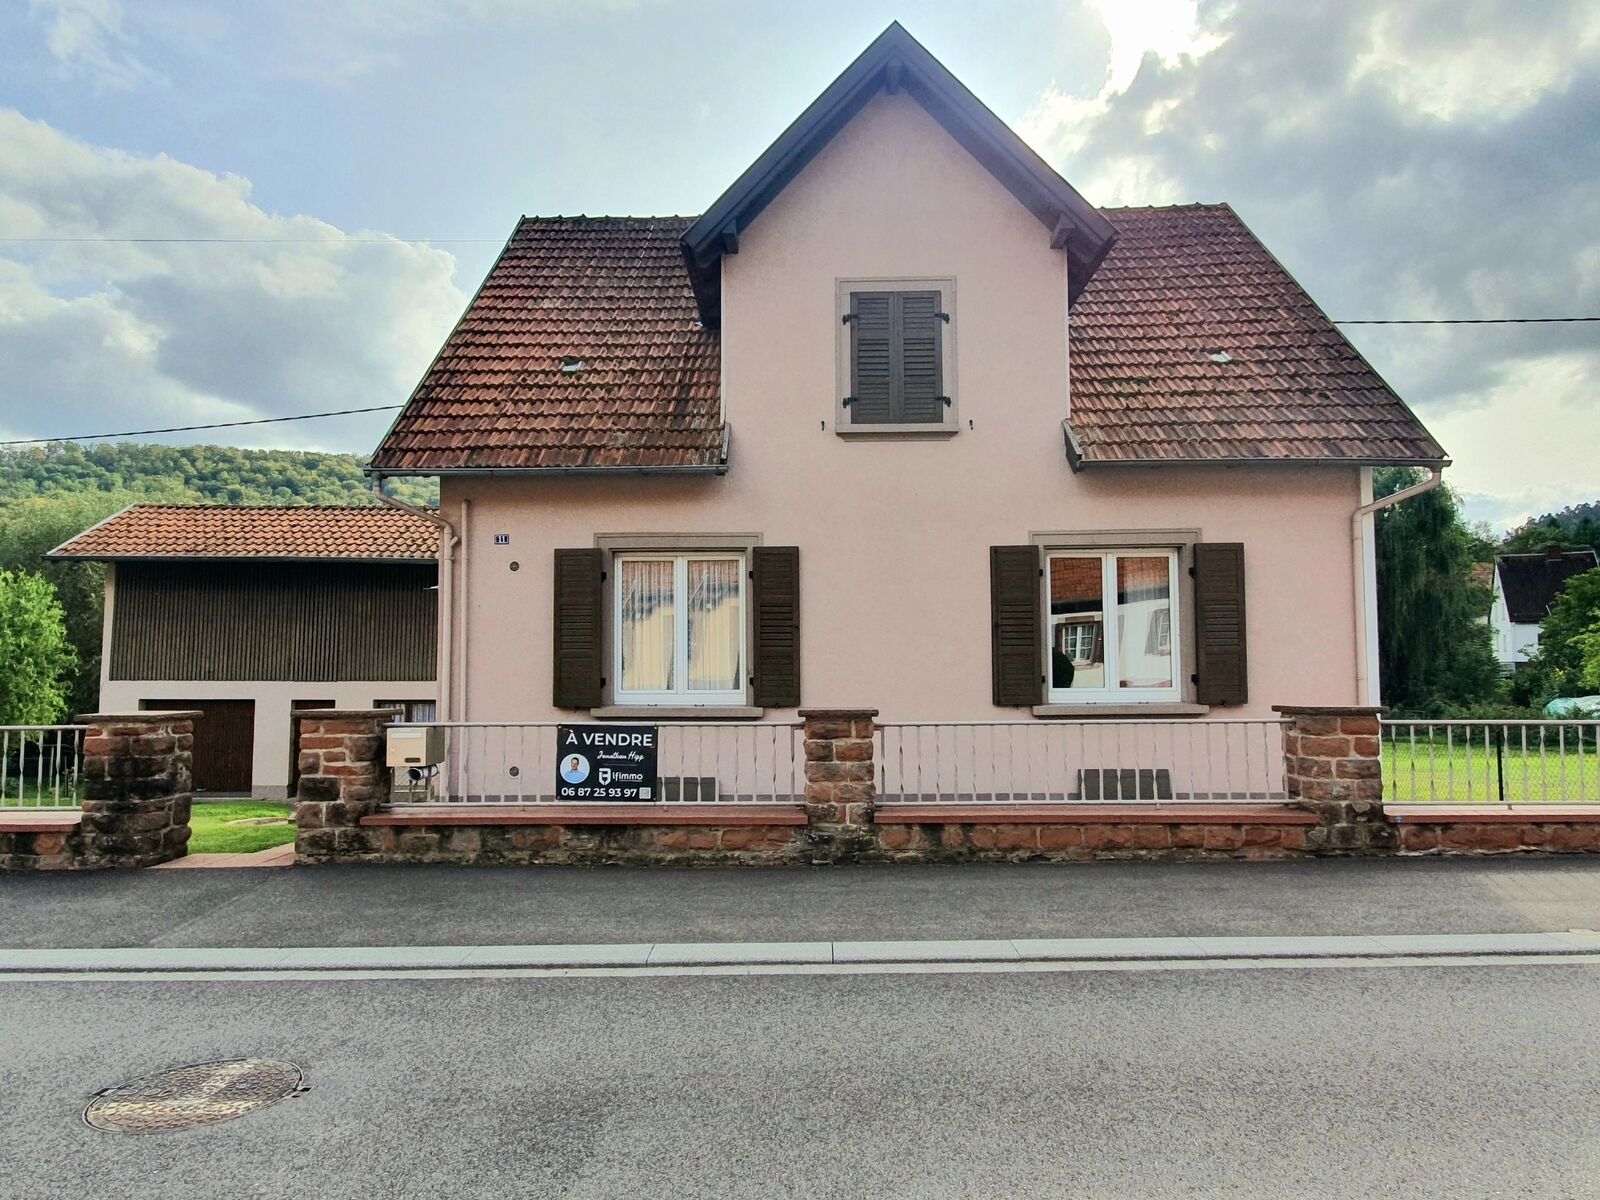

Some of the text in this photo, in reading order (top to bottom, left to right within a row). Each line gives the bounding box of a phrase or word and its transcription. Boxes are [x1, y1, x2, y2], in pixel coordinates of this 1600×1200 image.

[565, 729, 653, 747] À VENDRE
[561, 787, 637, 797] 06 87 25 93 97
